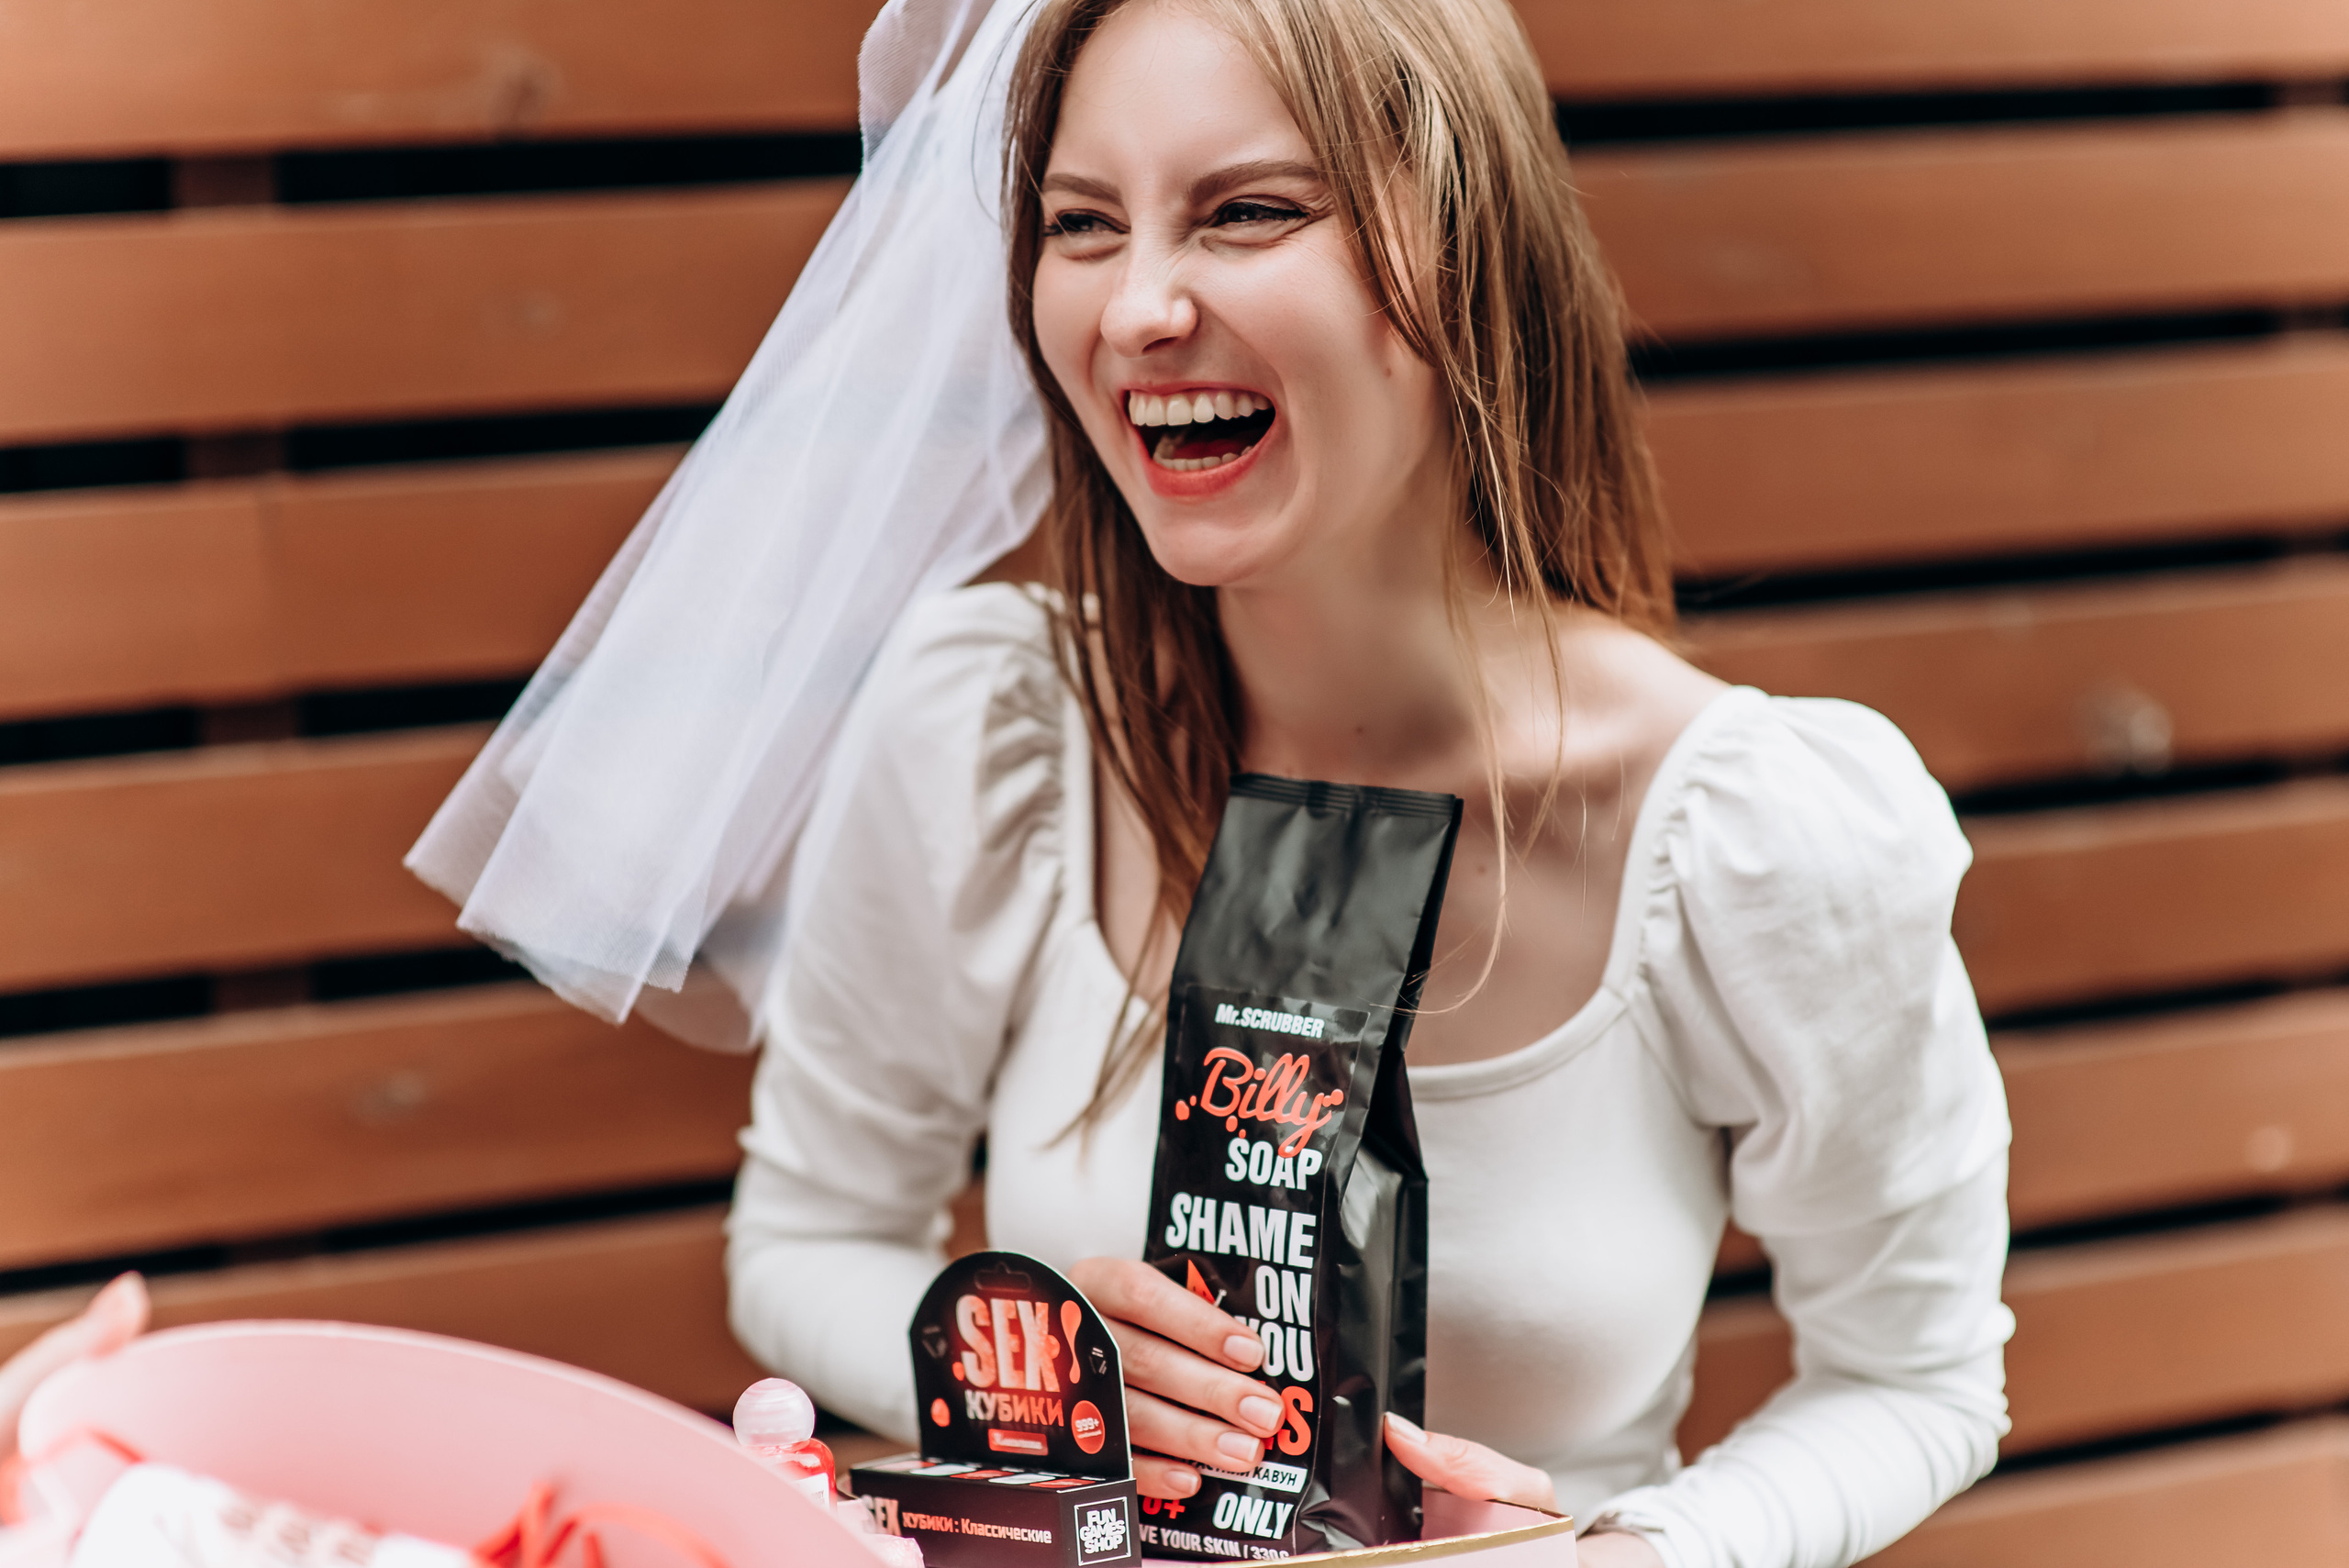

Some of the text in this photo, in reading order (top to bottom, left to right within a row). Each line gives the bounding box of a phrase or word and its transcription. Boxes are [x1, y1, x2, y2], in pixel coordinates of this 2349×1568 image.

[1214, 1003, 1325, 1039] Mr.SCRUBBER
[1200, 1047, 1332, 1159] Billy
[1225, 1137, 1323, 1191] SOAP
[1164, 1192, 1317, 1269] SHAME
[1254, 1264, 1313, 1327] ON
[965, 1389, 1064, 1428] КУБИКИ
[1074, 1417, 1100, 1433] 999+
[1252, 1465, 1298, 1487] КАВУН
[960, 1518, 1052, 1544] Классические
[1079, 1519, 1127, 1542] GAMES
[1086, 1507, 1117, 1529] FUN
[1212, 1492, 1294, 1540] ONLY
[1084, 1534, 1124, 1554] SHOP
[1160, 1528, 1203, 1552] YOUR
[1203, 1535, 1242, 1559] SKIN
